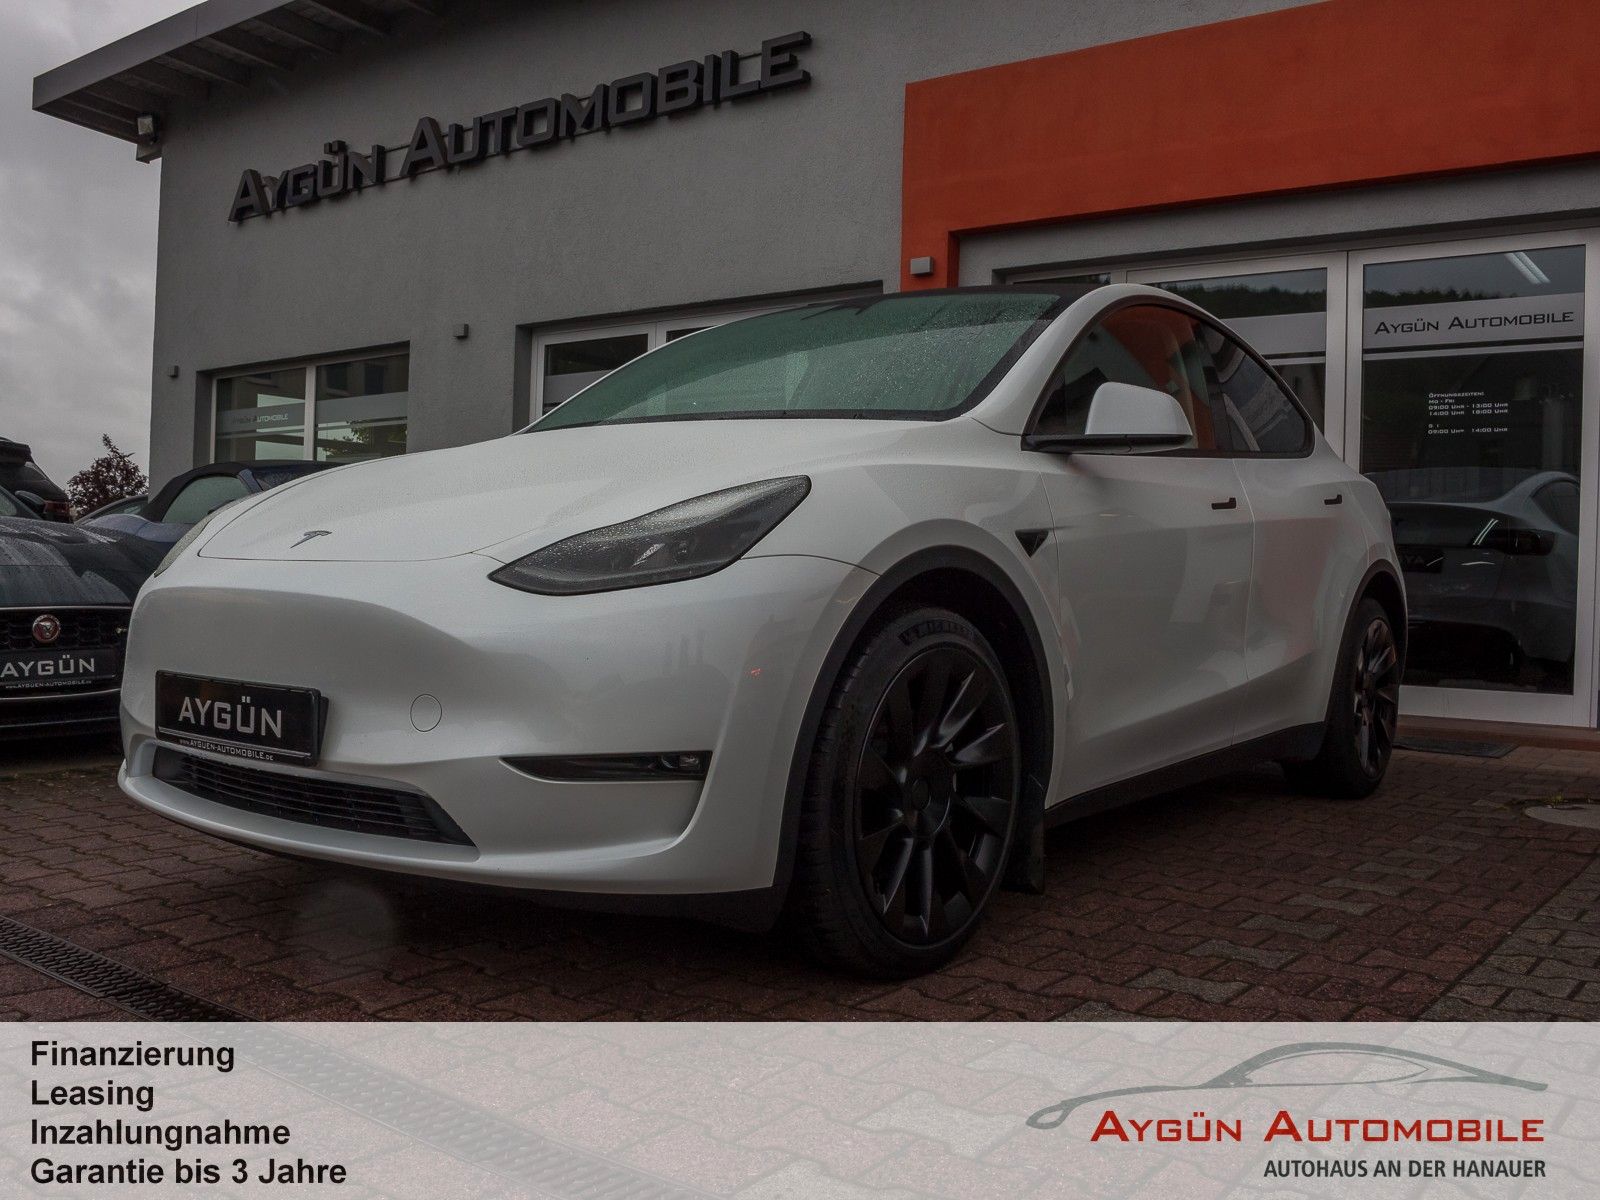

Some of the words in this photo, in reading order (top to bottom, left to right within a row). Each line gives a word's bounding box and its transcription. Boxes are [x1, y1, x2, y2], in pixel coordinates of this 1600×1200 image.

[228, 140, 385, 223] AYGÜN
[401, 31, 812, 177] AUTOMOBILE
[1375, 318, 1439, 334] AYGÜN
[1448, 311, 1573, 330] AUTOMOBILE
[0, 654, 95, 678] AYGÜN
[178, 695, 282, 738] AYGÜN
